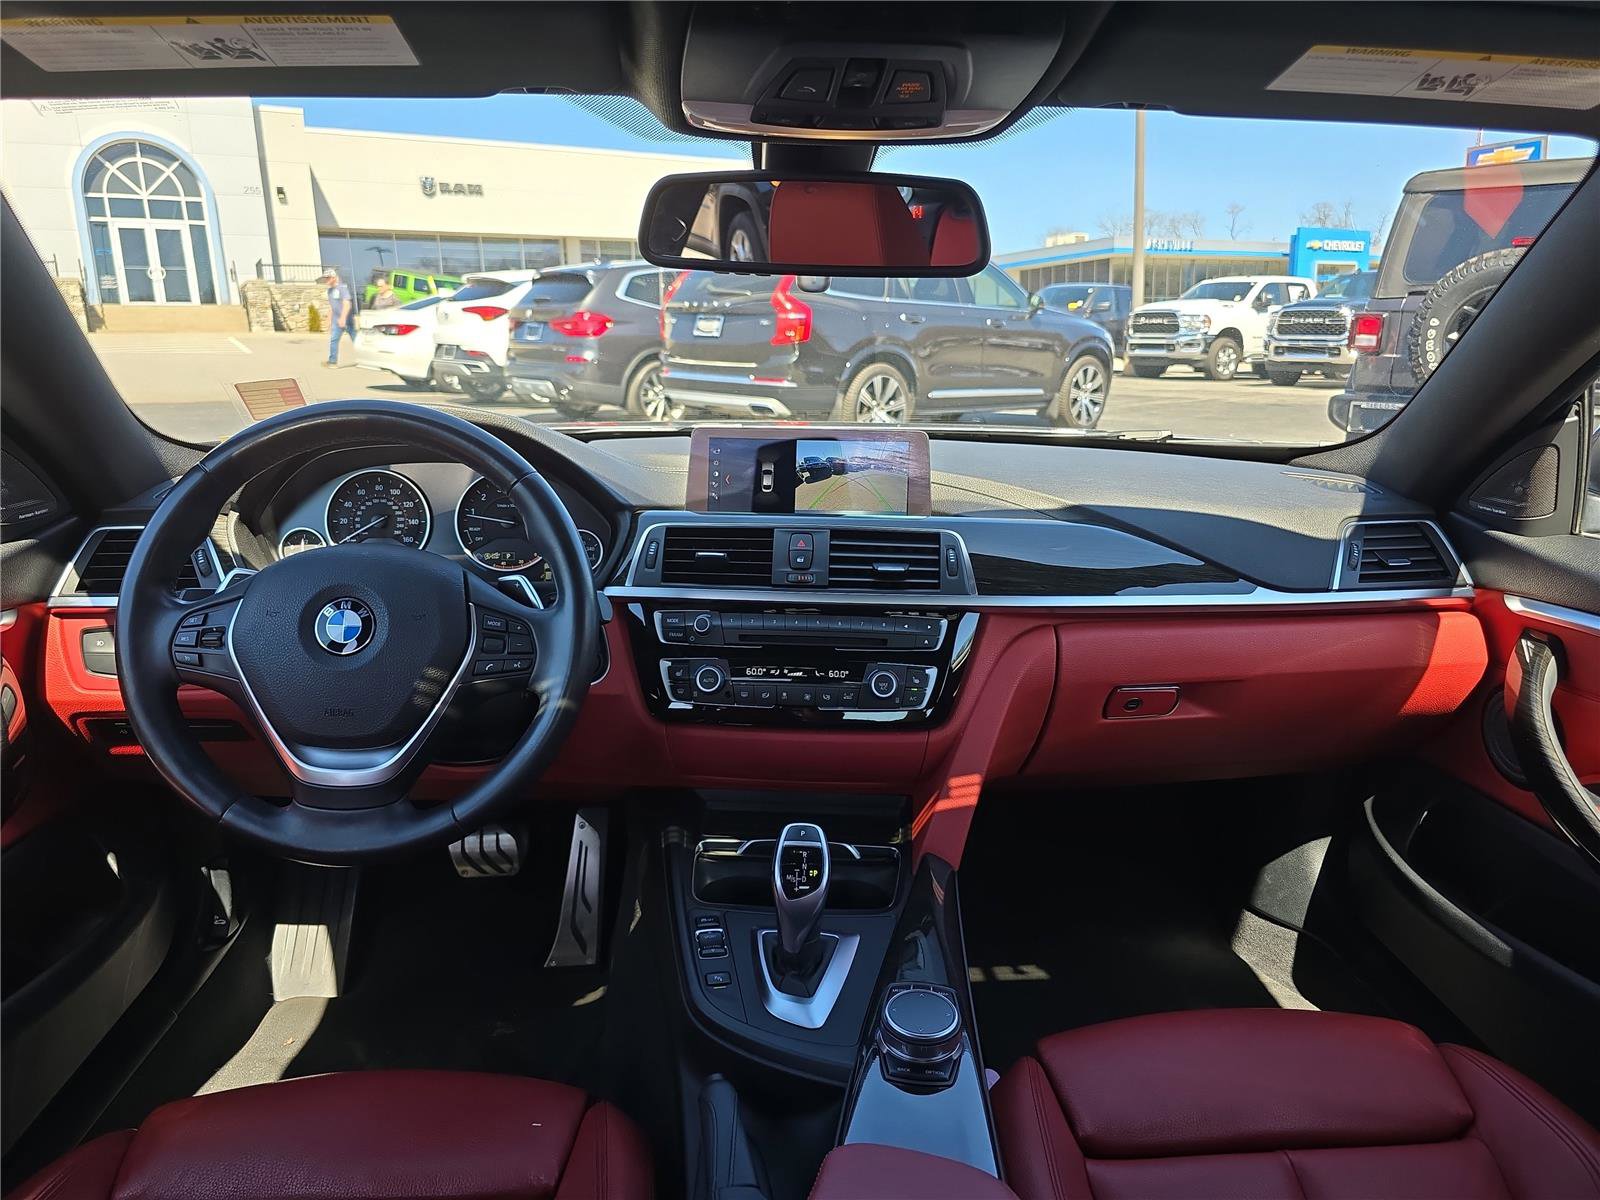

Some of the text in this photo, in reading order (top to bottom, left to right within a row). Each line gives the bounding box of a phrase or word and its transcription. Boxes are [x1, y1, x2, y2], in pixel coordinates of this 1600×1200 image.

[244, 16, 371, 24] AVERTISSEMENT
[1346, 47, 1412, 57] WARNING
[439, 182, 483, 195] RAM
[1323, 239, 1365, 252] CHEVROLET
